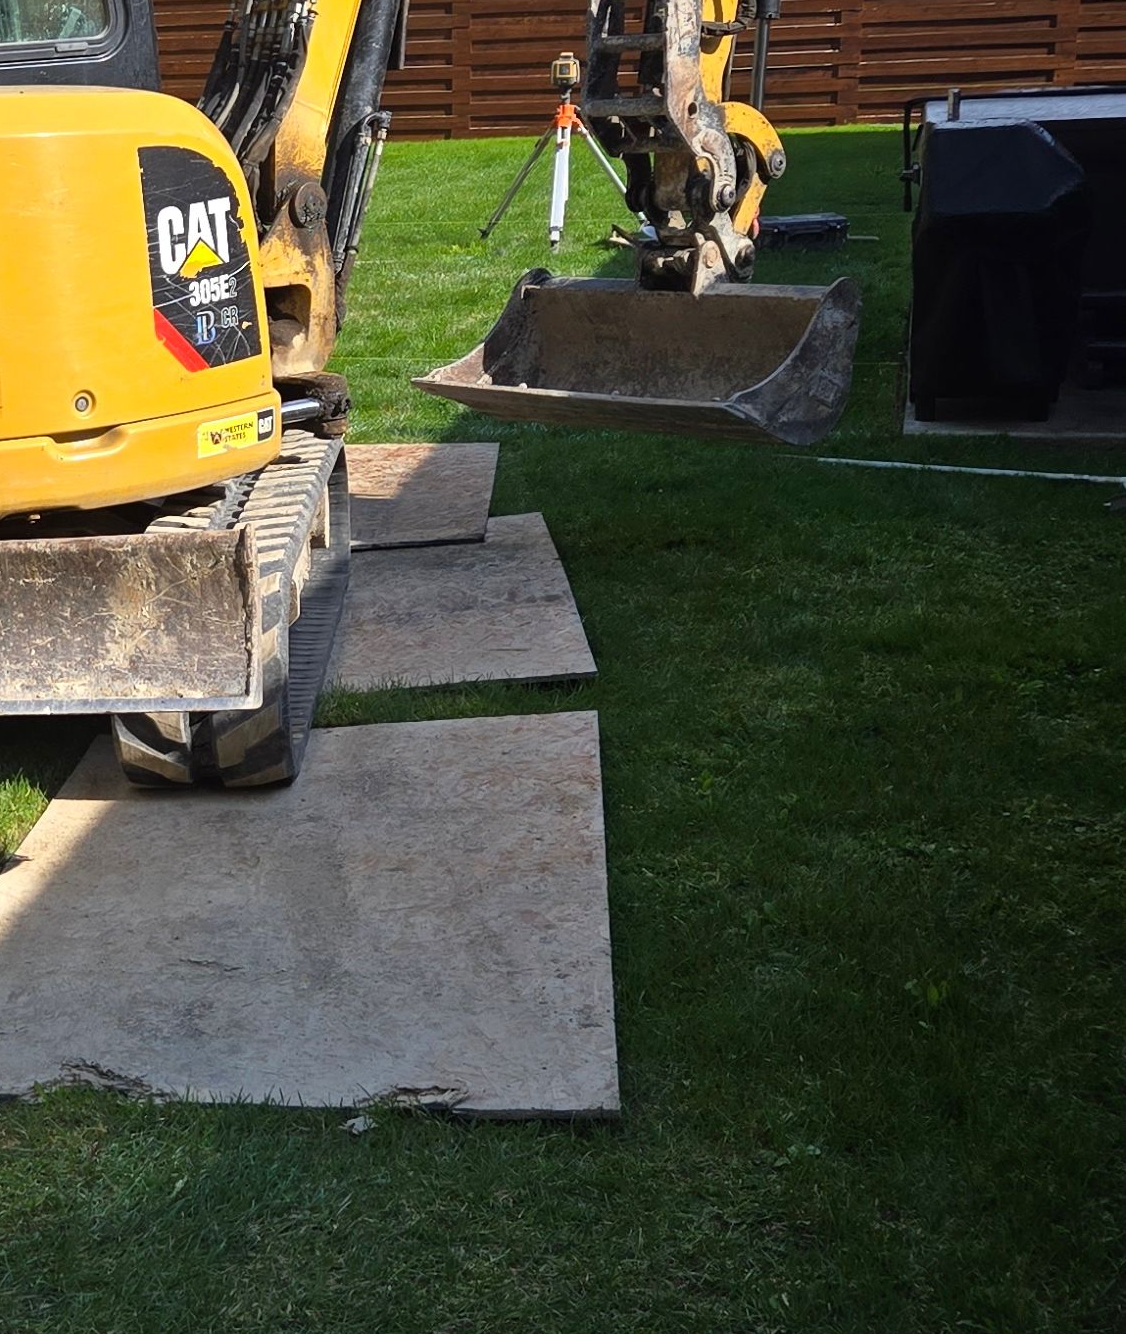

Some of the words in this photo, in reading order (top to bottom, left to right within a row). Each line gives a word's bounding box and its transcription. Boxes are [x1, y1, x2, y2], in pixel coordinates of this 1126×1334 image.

[157, 197, 231, 275] CAT
[189, 274, 237, 307] 305E2
[221, 305, 239, 328] CR
[258, 416, 273, 434] CAT
[224, 432, 246, 443] STATES
